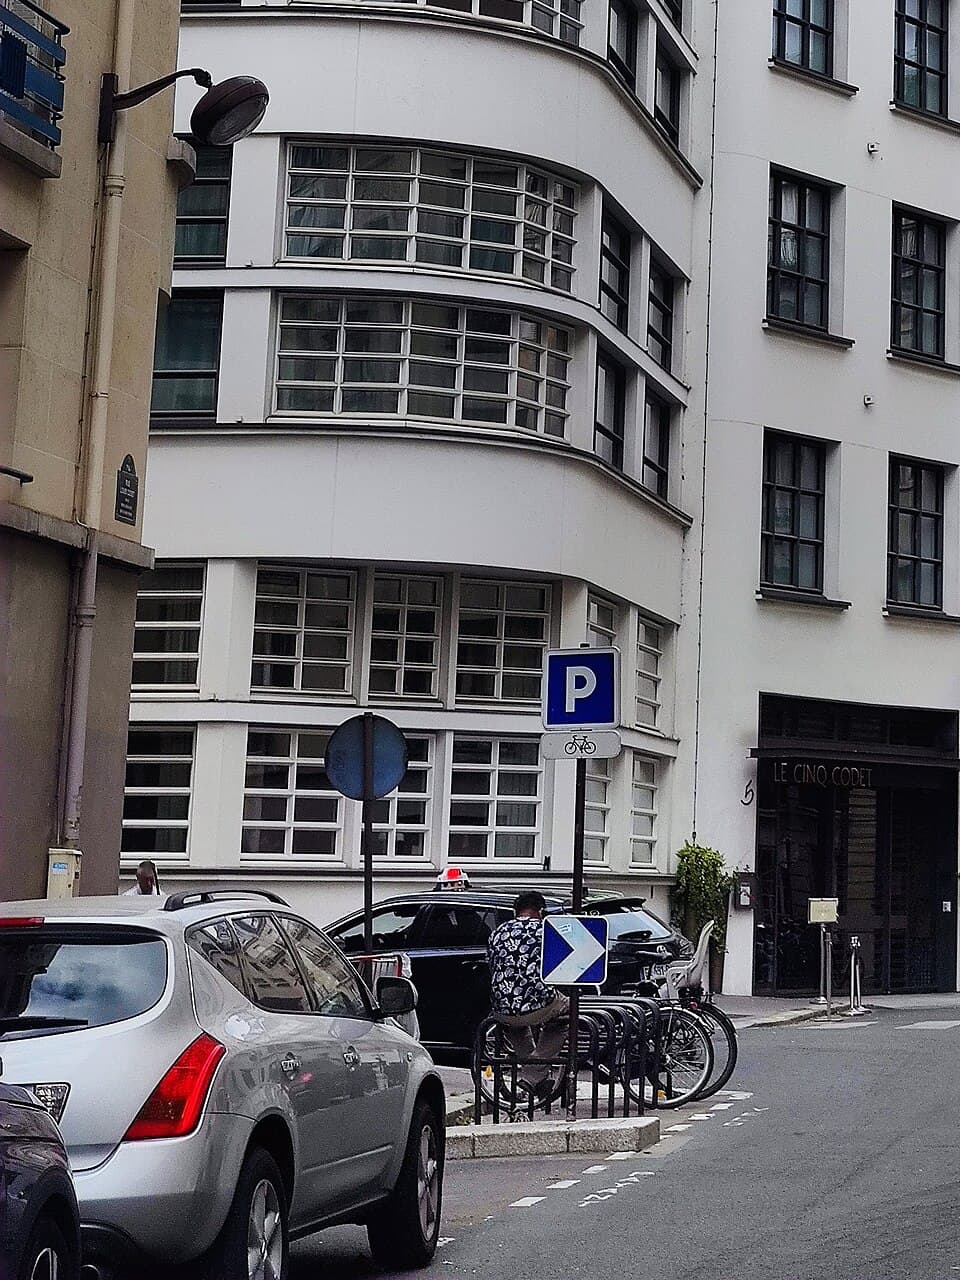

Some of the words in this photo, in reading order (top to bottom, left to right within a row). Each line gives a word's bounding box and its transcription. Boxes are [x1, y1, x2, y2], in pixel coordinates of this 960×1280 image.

[566, 666, 597, 713] P
[774, 762, 788, 782] LE
[793, 764, 828, 788] CINQ
[831, 766, 873, 787] CODET
[740, 779, 754, 806] 5
